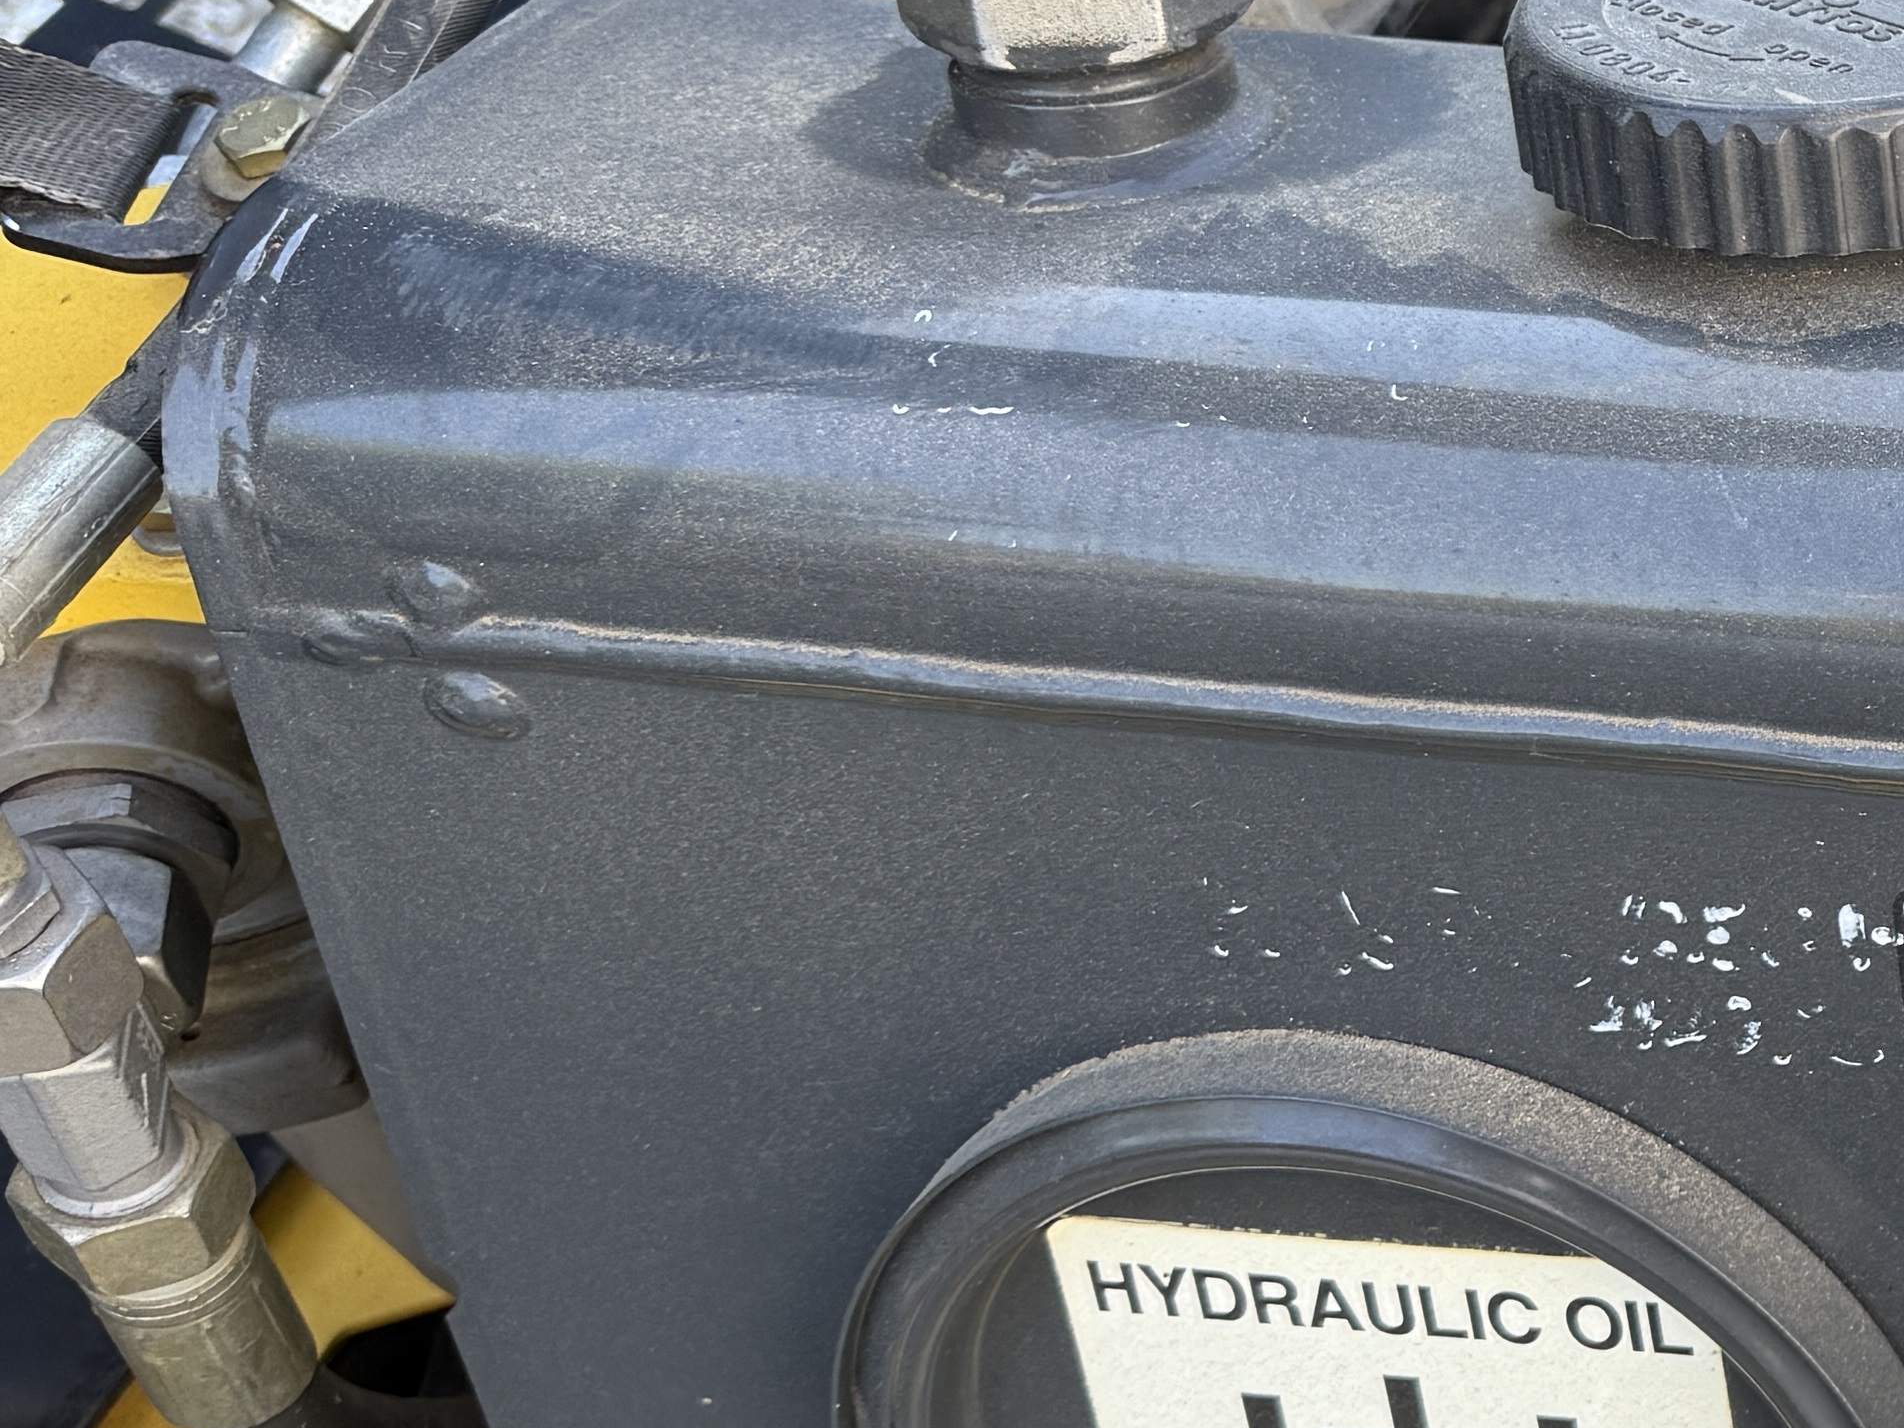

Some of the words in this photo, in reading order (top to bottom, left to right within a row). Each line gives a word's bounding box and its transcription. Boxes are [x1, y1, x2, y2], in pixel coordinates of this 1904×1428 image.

[1763, 41, 1857, 76] open
[1086, 1259, 1543, 1347] HYDRAULIC
[1564, 1295, 1695, 1357] OIL
